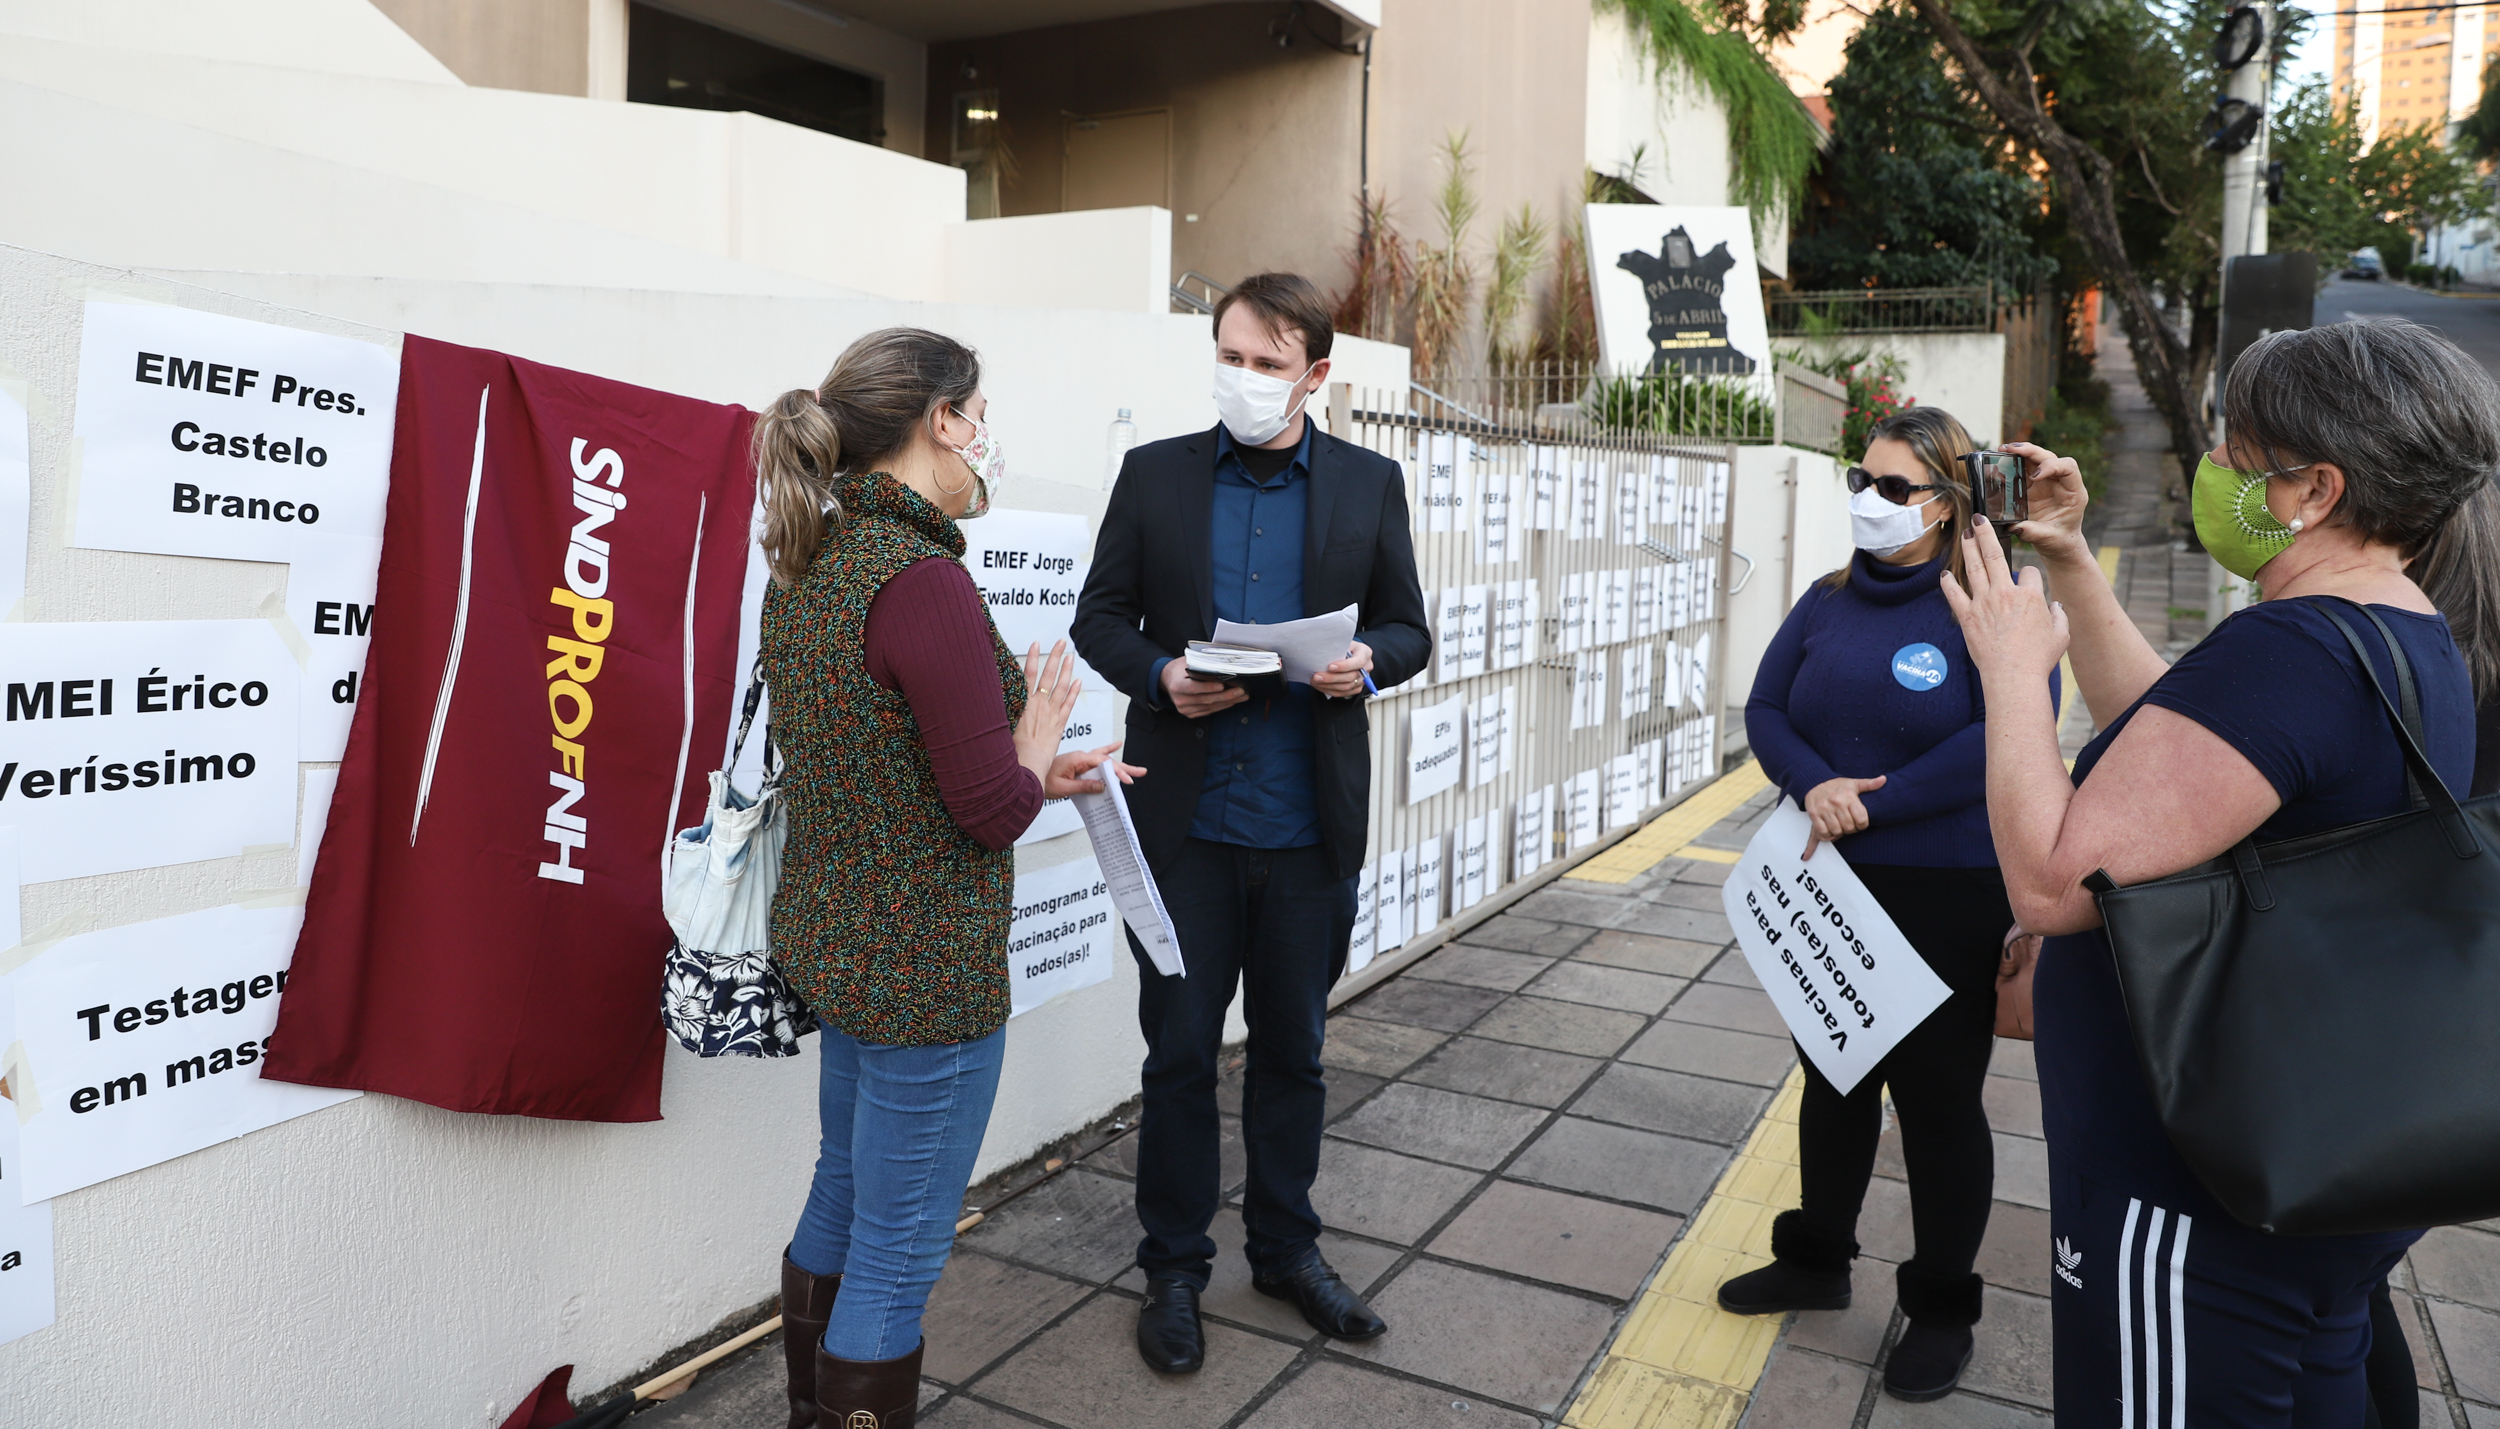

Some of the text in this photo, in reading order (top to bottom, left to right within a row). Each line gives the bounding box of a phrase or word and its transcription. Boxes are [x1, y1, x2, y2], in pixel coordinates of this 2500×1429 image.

[1647, 272, 1722, 300] PALÁCIO
[1653, 310, 1663, 326] 5
[1679, 308, 1727, 325] ABRIL
[135, 351, 366, 416] EMEF Pres.
[171, 421, 328, 468] Castelo
[172, 482, 320, 525] Branco
[983, 550, 1074, 575] EMEF Jorge
[1039, 588, 1075, 605] Koch
[137, 667, 269, 714] Érico
[1897, 662, 1926, 677] VACINA
[0, 678, 113, 722] MEI
[1011, 881, 1107, 922] Cronograma de
[1379, 894, 1395, 908] ara
[1796, 869, 1876, 970] escolas!
[1008, 921, 1077, 955] vacinação
[1079, 911, 1107, 934] para
[1761, 864, 1875, 1029] todos(as) nas
[1026, 943, 1091, 979] todos(as)!
[1746, 890, 1848, 1052] Vacinas para
[70, 1070, 148, 1114] em
[2055, 1264, 2083, 1289] adidas
